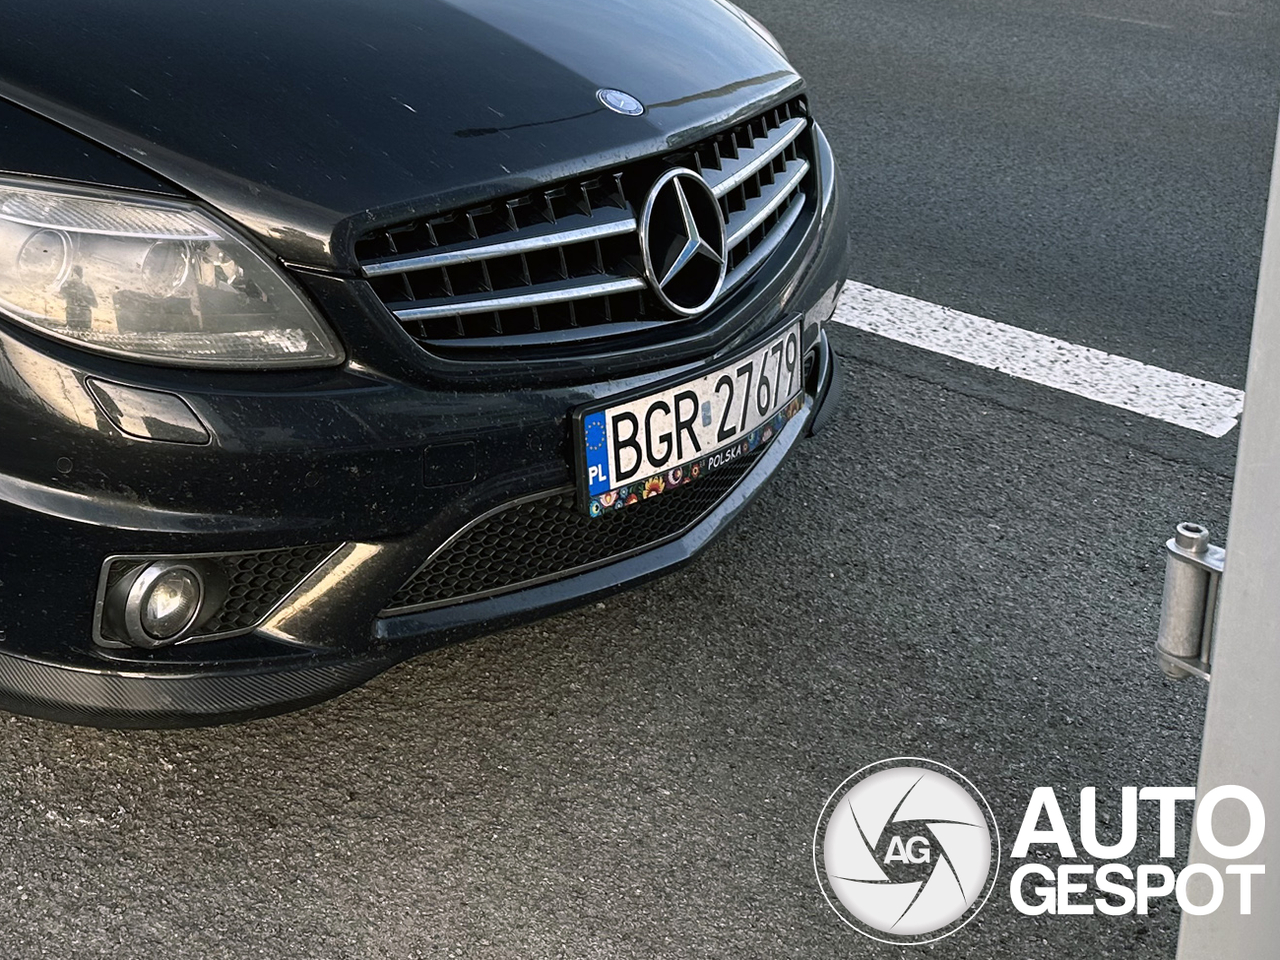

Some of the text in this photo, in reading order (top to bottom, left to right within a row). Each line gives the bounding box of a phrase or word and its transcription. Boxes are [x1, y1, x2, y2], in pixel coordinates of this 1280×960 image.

[611, 332, 797, 483] BGR 27679
[707, 444, 742, 470] POLSKA
[588, 463, 607, 485] PL
